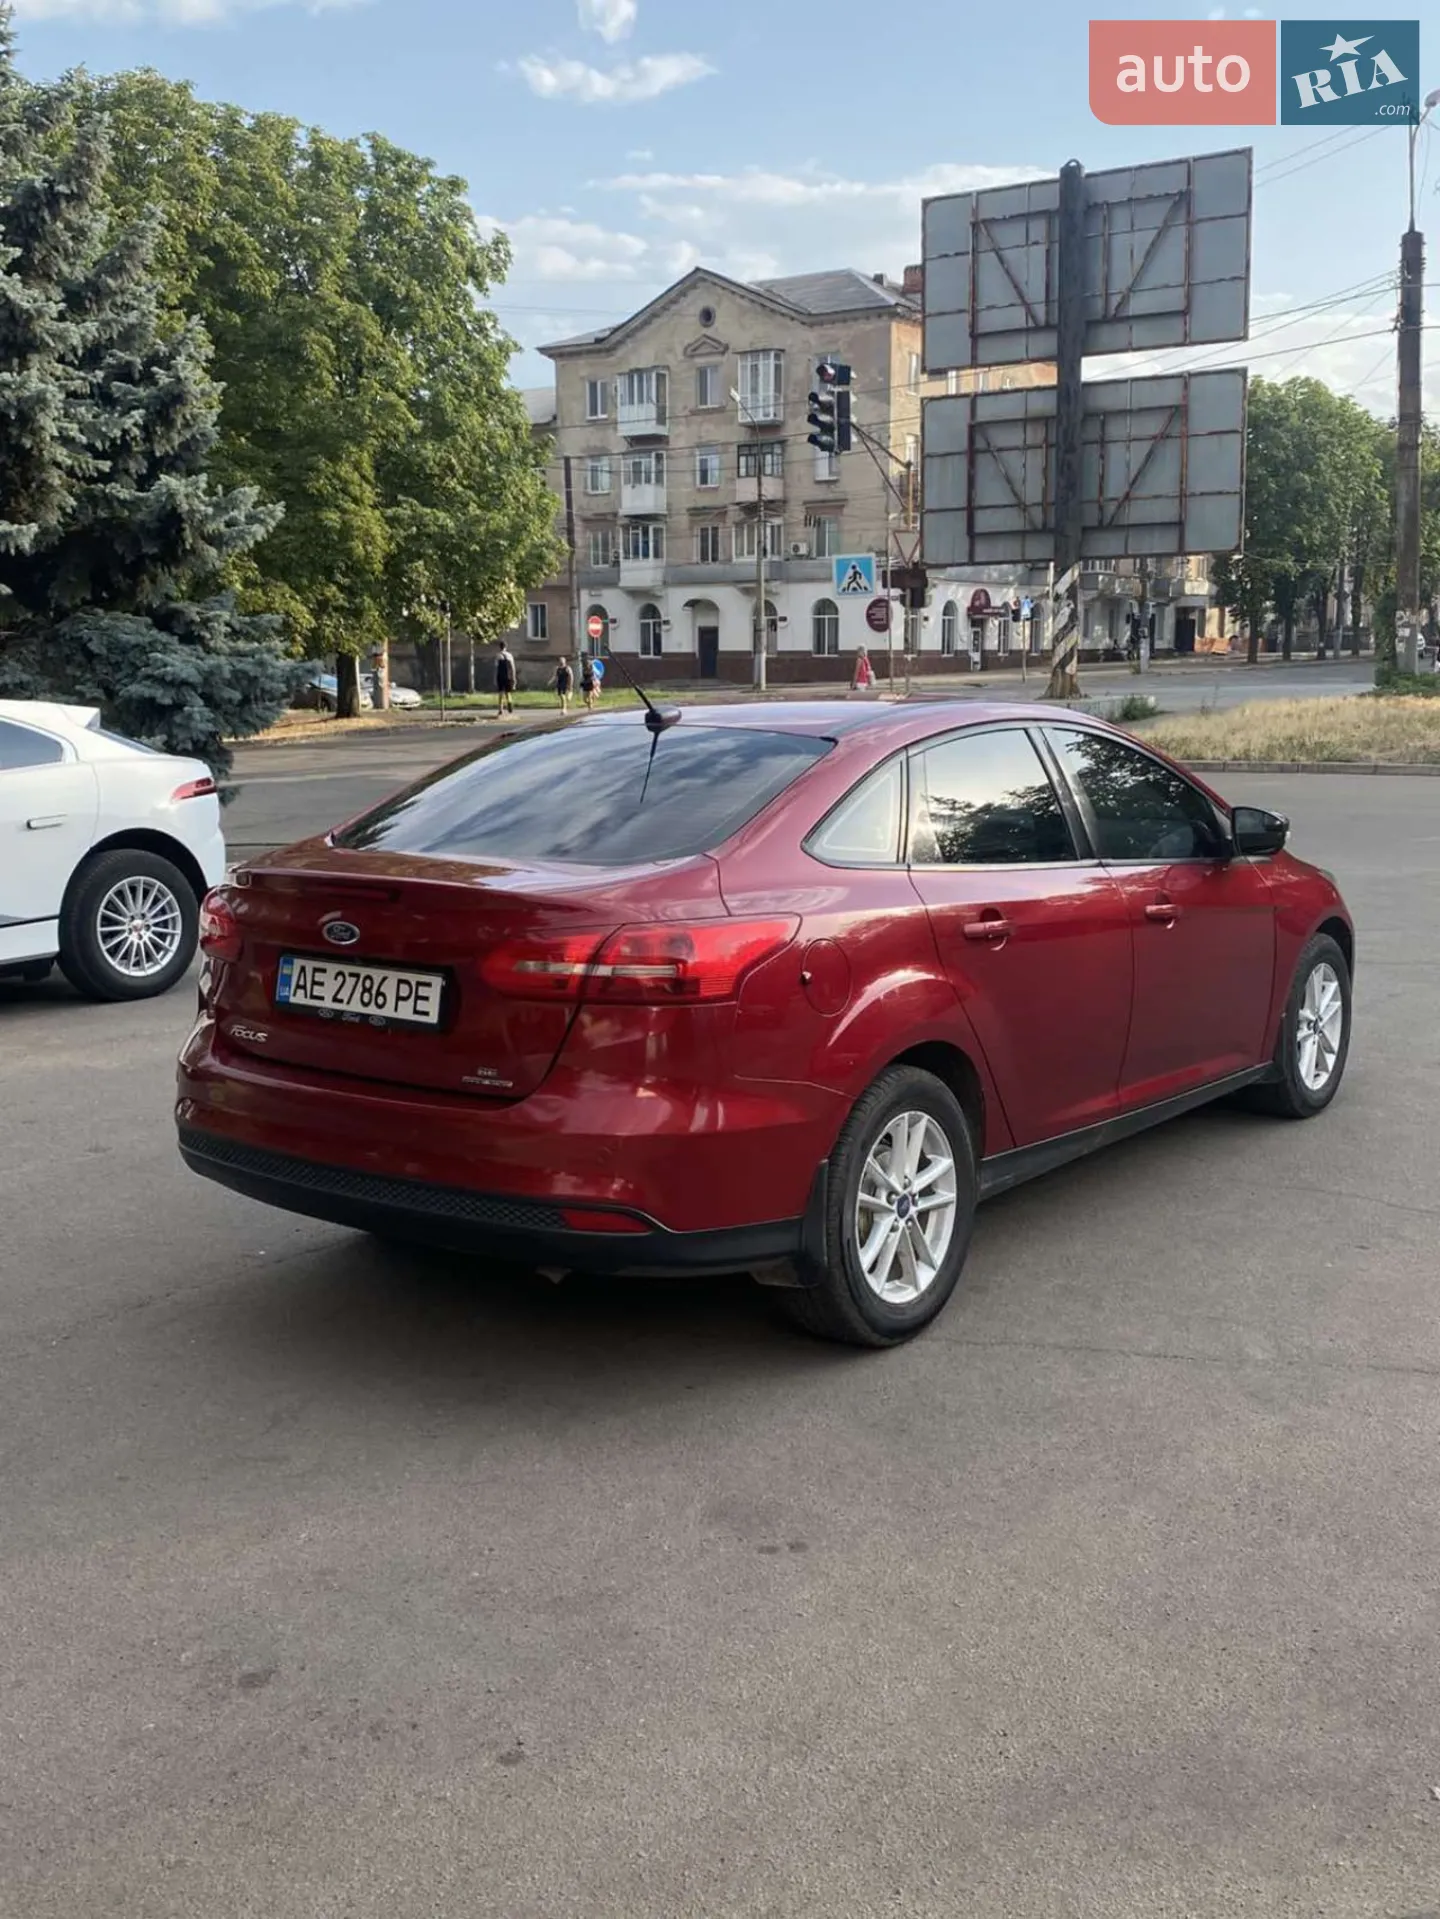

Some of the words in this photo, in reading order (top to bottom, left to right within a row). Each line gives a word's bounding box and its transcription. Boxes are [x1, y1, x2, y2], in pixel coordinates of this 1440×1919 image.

[292, 965, 327, 1002] AE
[332, 970, 389, 1010] 2786
[394, 978, 433, 1017] PE
